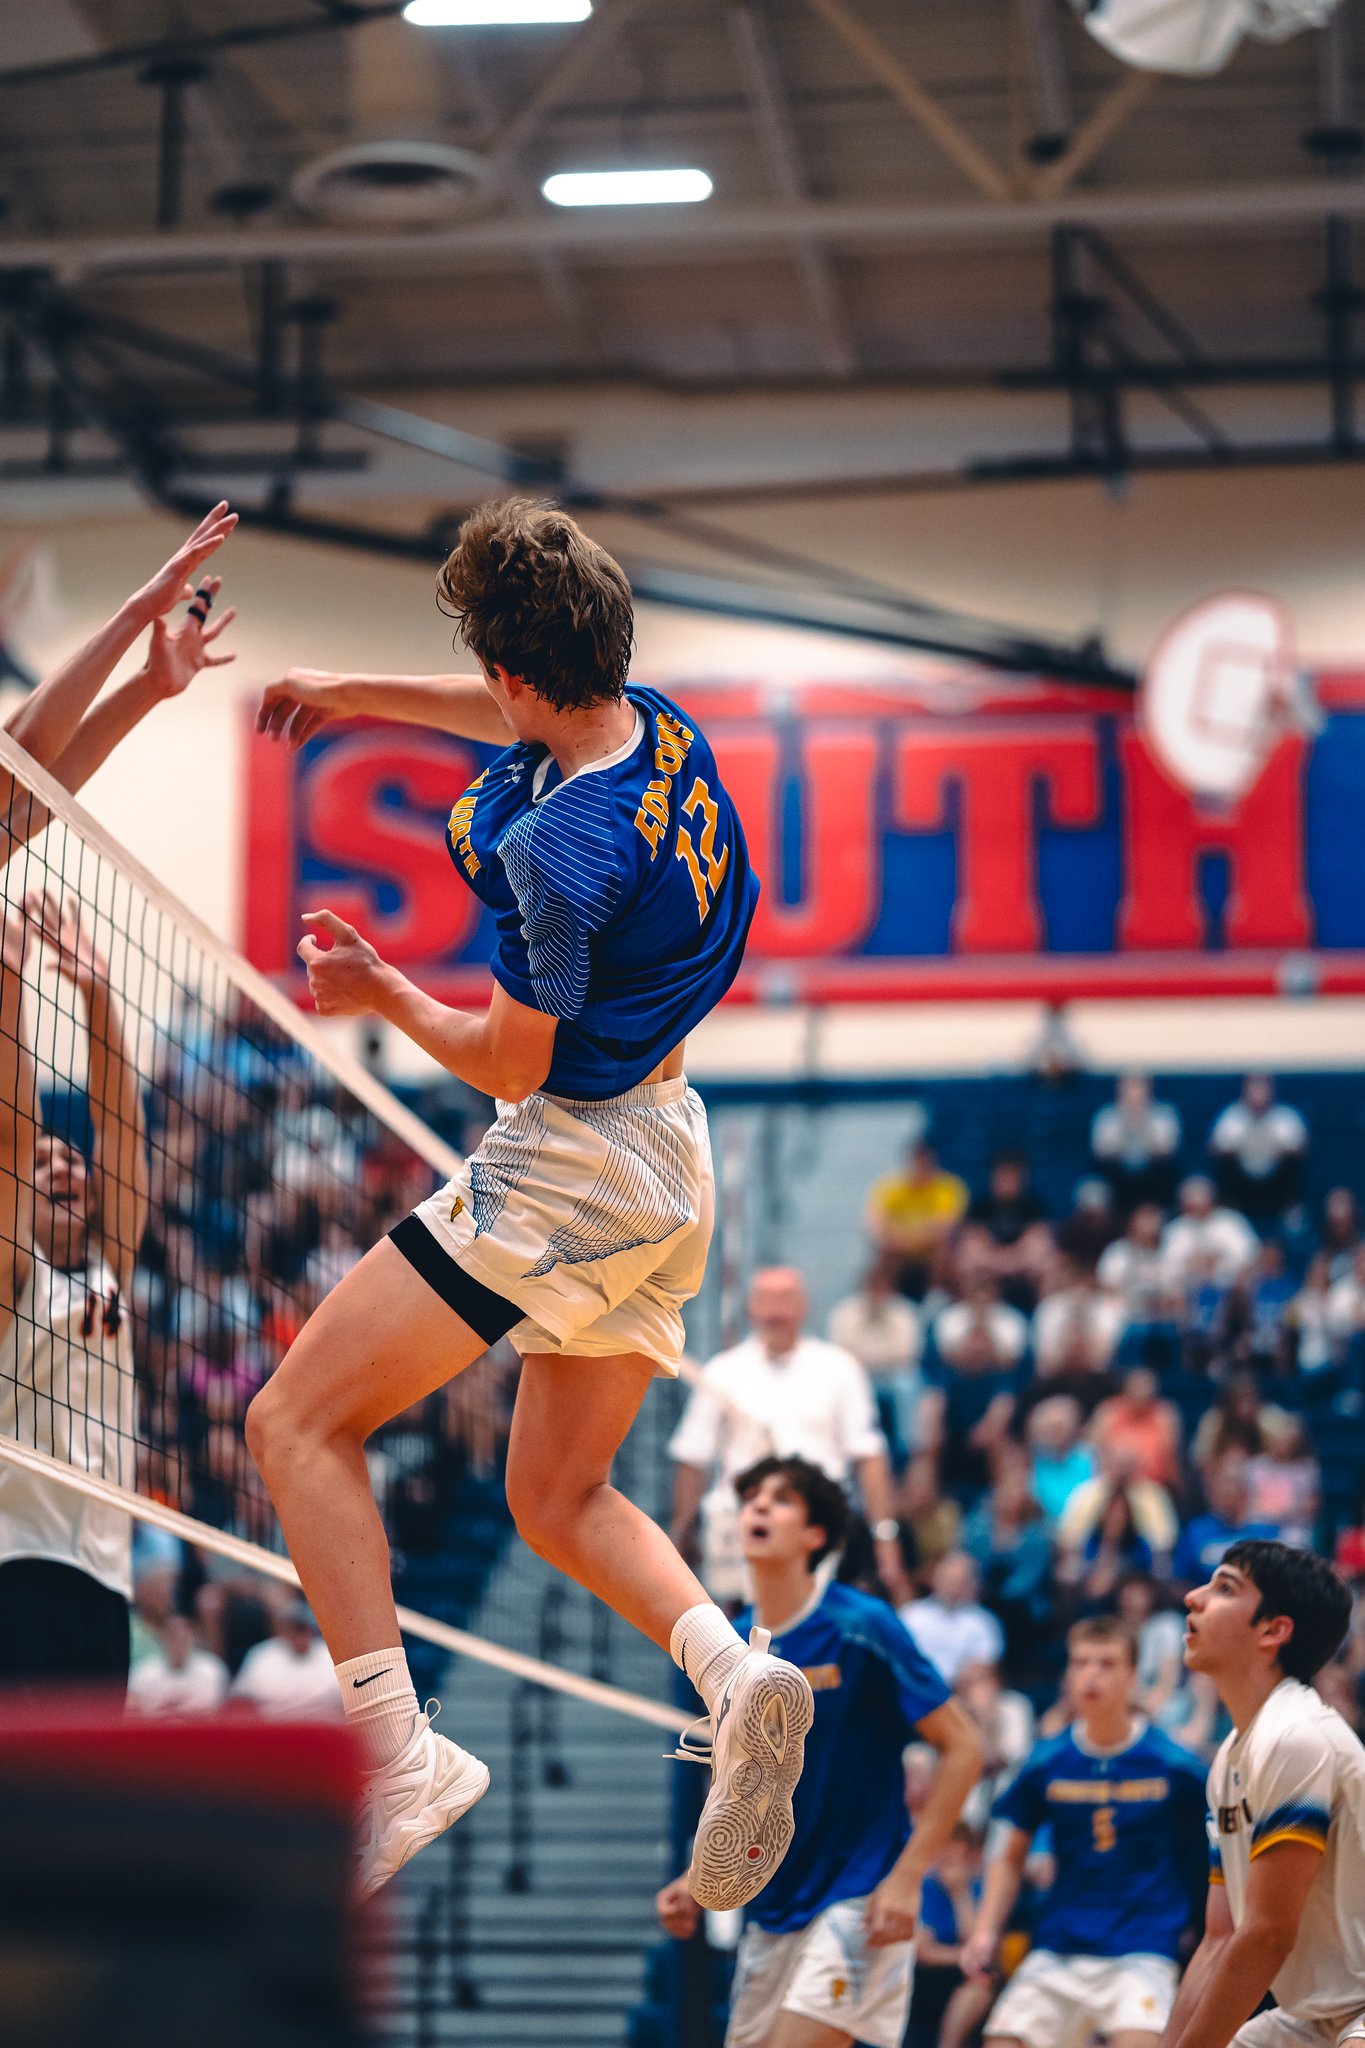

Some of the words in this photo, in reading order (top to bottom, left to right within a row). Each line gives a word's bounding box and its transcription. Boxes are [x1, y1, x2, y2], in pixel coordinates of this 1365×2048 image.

[308, 729, 1312, 948] SUTH
[634, 711, 694, 862] FALONS
[675, 776, 729, 926] 12
